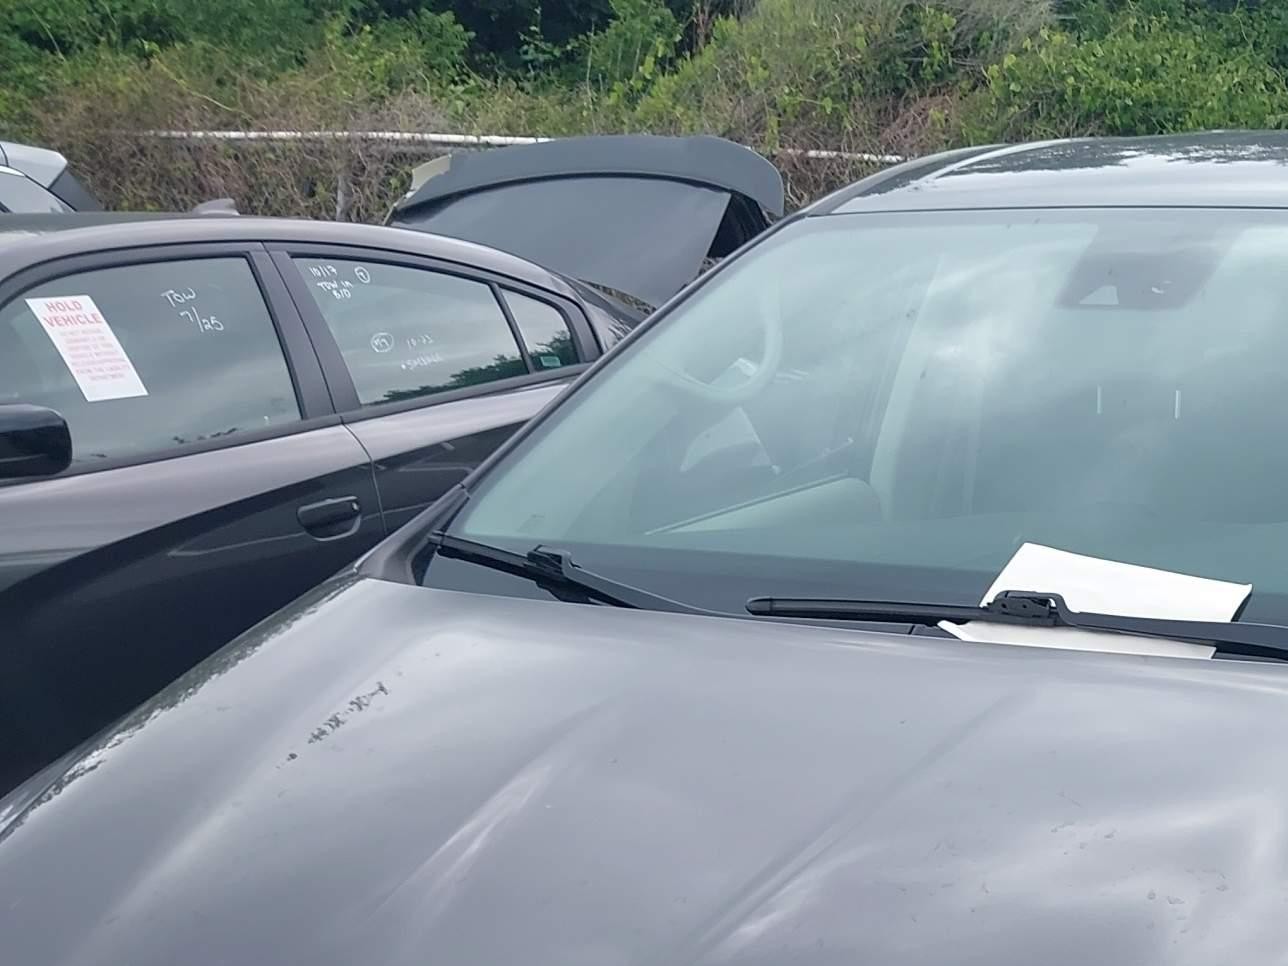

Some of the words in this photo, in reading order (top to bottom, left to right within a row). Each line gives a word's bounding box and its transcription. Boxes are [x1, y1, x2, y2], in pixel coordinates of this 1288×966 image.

[44, 300, 83, 313] HOLD
[42, 313, 103, 327] VEHICLE
[179, 306, 224, 333] 7/25
